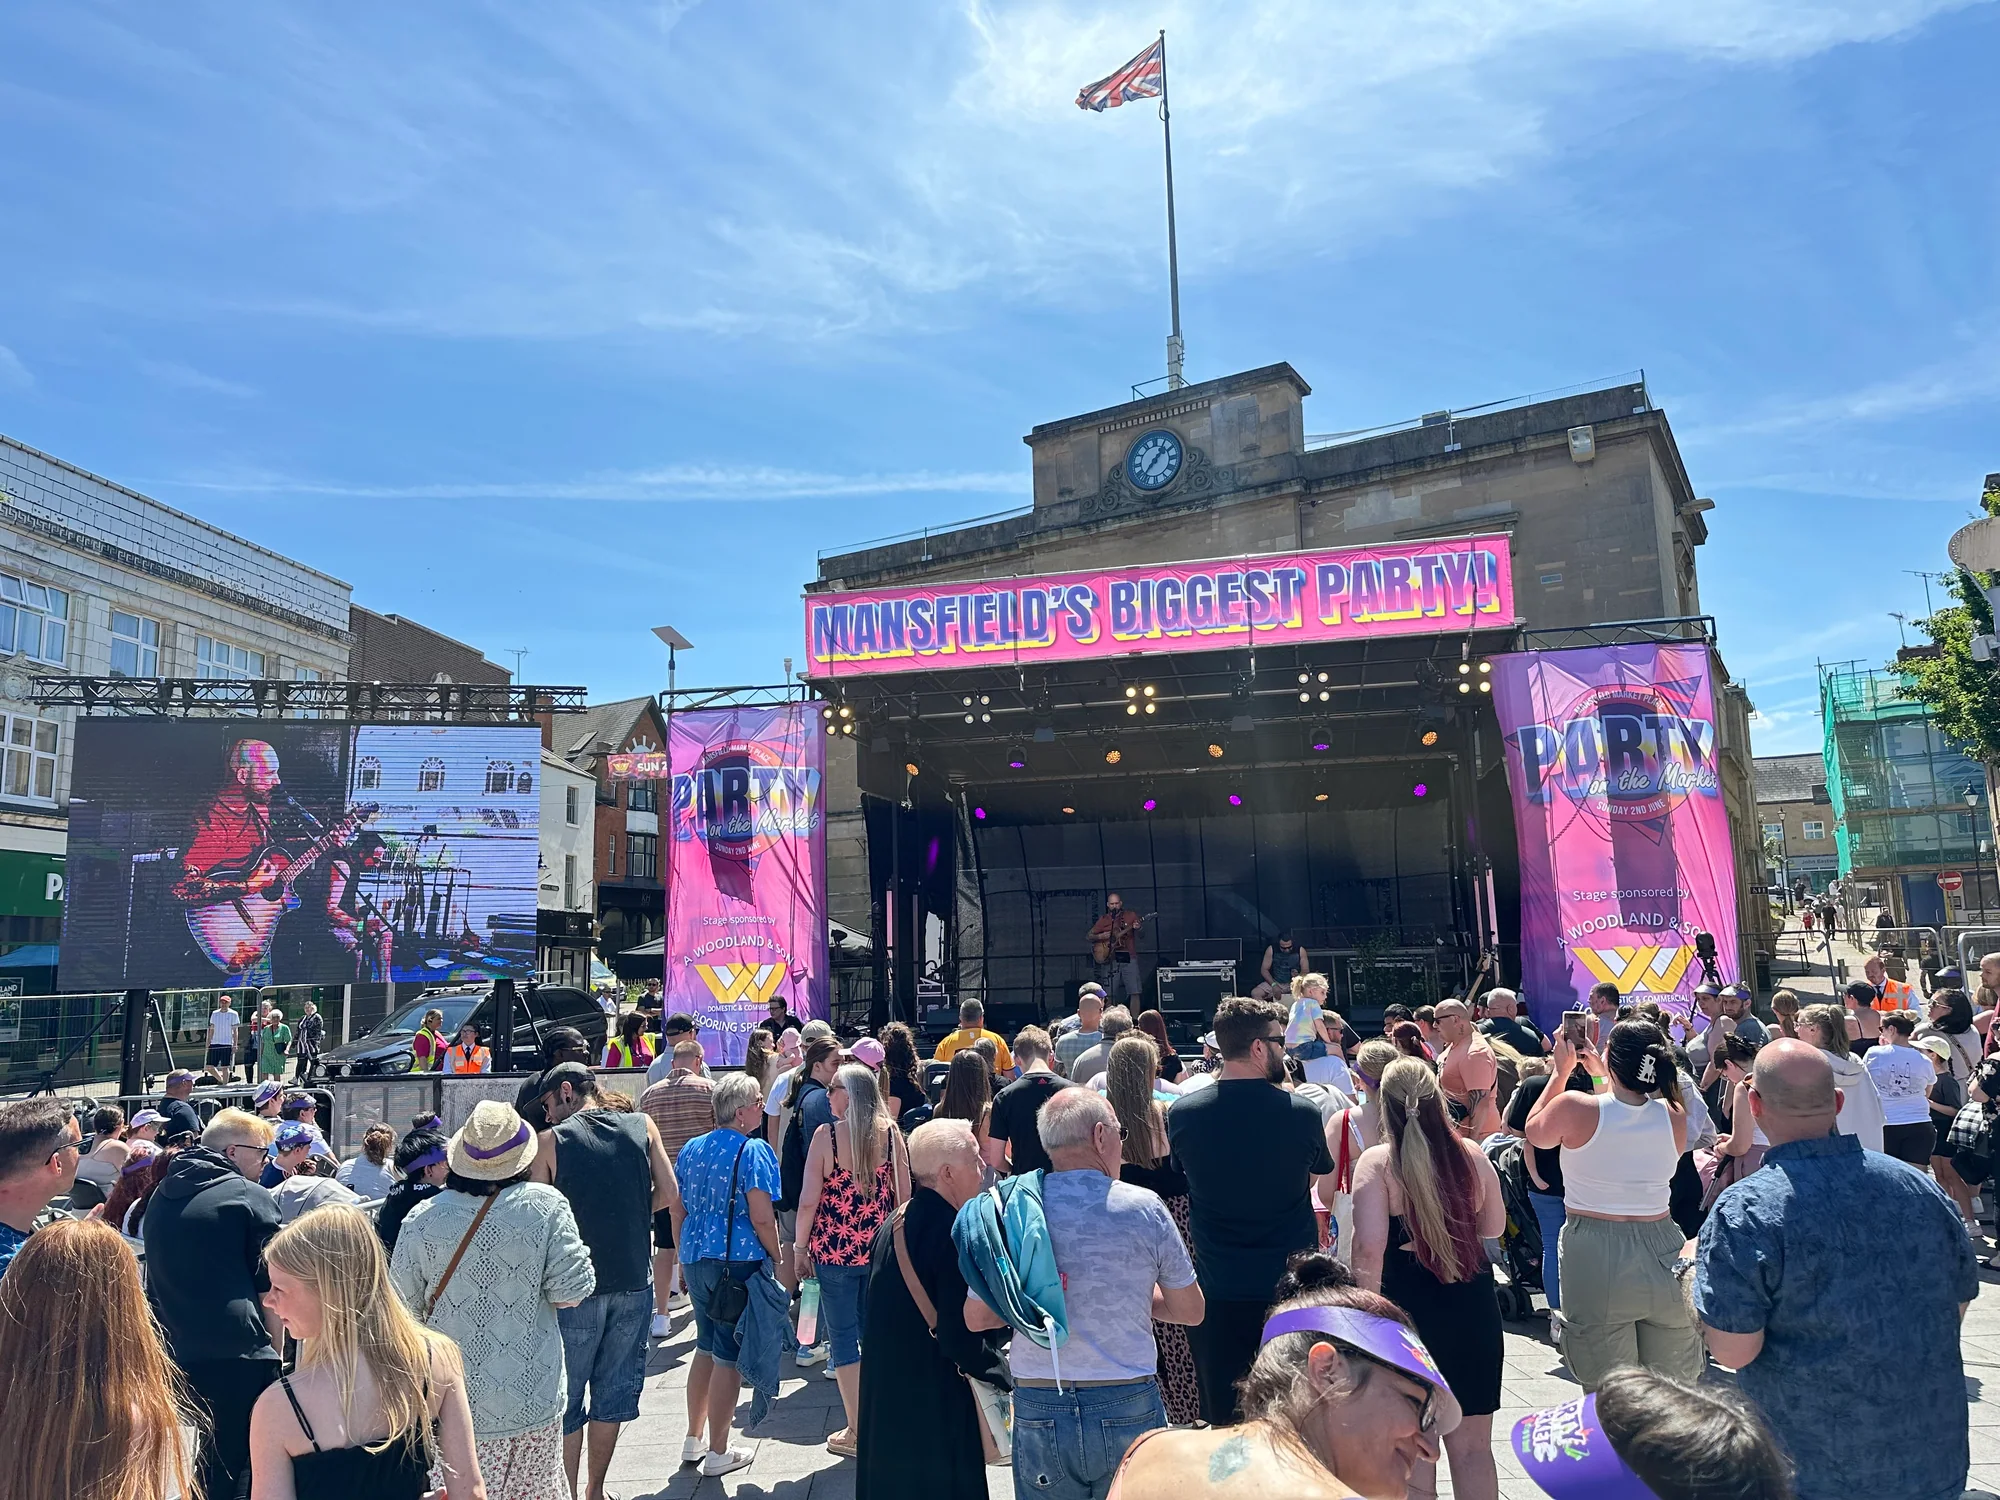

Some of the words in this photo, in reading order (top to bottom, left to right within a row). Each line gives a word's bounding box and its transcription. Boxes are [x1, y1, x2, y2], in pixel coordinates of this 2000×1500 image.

[813, 583, 1101, 662] MANSFIELD'S
[1110, 567, 1306, 642] BIGGEST
[1317, 550, 1501, 619] PARTY!
[1612, 690, 1642, 700] MARKET
[1643, 694, 1666, 710] PLACE
[754, 748, 772, 763] PLACE
[1517, 714, 1715, 804] PARTY
[637, 762, 659, 772] SUN
[1589, 779, 1610, 796] on
[1618, 767, 1650, 791] the
[1658, 762, 1717, 791] Market
[672, 766, 821, 842] PARTY
[1596, 801, 1629, 815] SUNDAY
[1630, 804, 1647, 815] 2ND
[1648, 799, 1667, 813] JUNE
[709, 823, 722, 837] on
[727, 813, 750, 834] the
[756, 808, 820, 833] Market
[714, 842, 734, 855] SUNDAY
[735, 846, 746, 855] 2ND
[1925, 853, 1961, 862] MAKET
[1963, 852, 1992, 860] PLCE
[1573, 890, 1607, 901] Stage
[1611, 887, 1673, 900] sponsored
[1677, 887, 1690, 899] by
[703, 916, 727, 926] Stage
[730, 915, 766, 925] sponsored
[767, 915, 776, 926] by
[1556, 936, 1568, 948] A
[1568, 912, 1664, 940] WOODLAND
[1669, 916, 1679, 929] &
[1683, 921, 1706, 938] SO
[683, 956, 693, 966] A
[693, 935, 765, 958] WOODLAND
[767, 939, 774, 949] &
[776, 943, 795, 965] SON
[707, 1004, 737, 1013] DOMESTIC
[1635, 995, 1642, 1003] &
[1642, 994, 1690, 1003] COMMERCIAL
[692, 1010, 738, 1032] FLOORING
[1559, 1399, 1584, 1441] RTY
